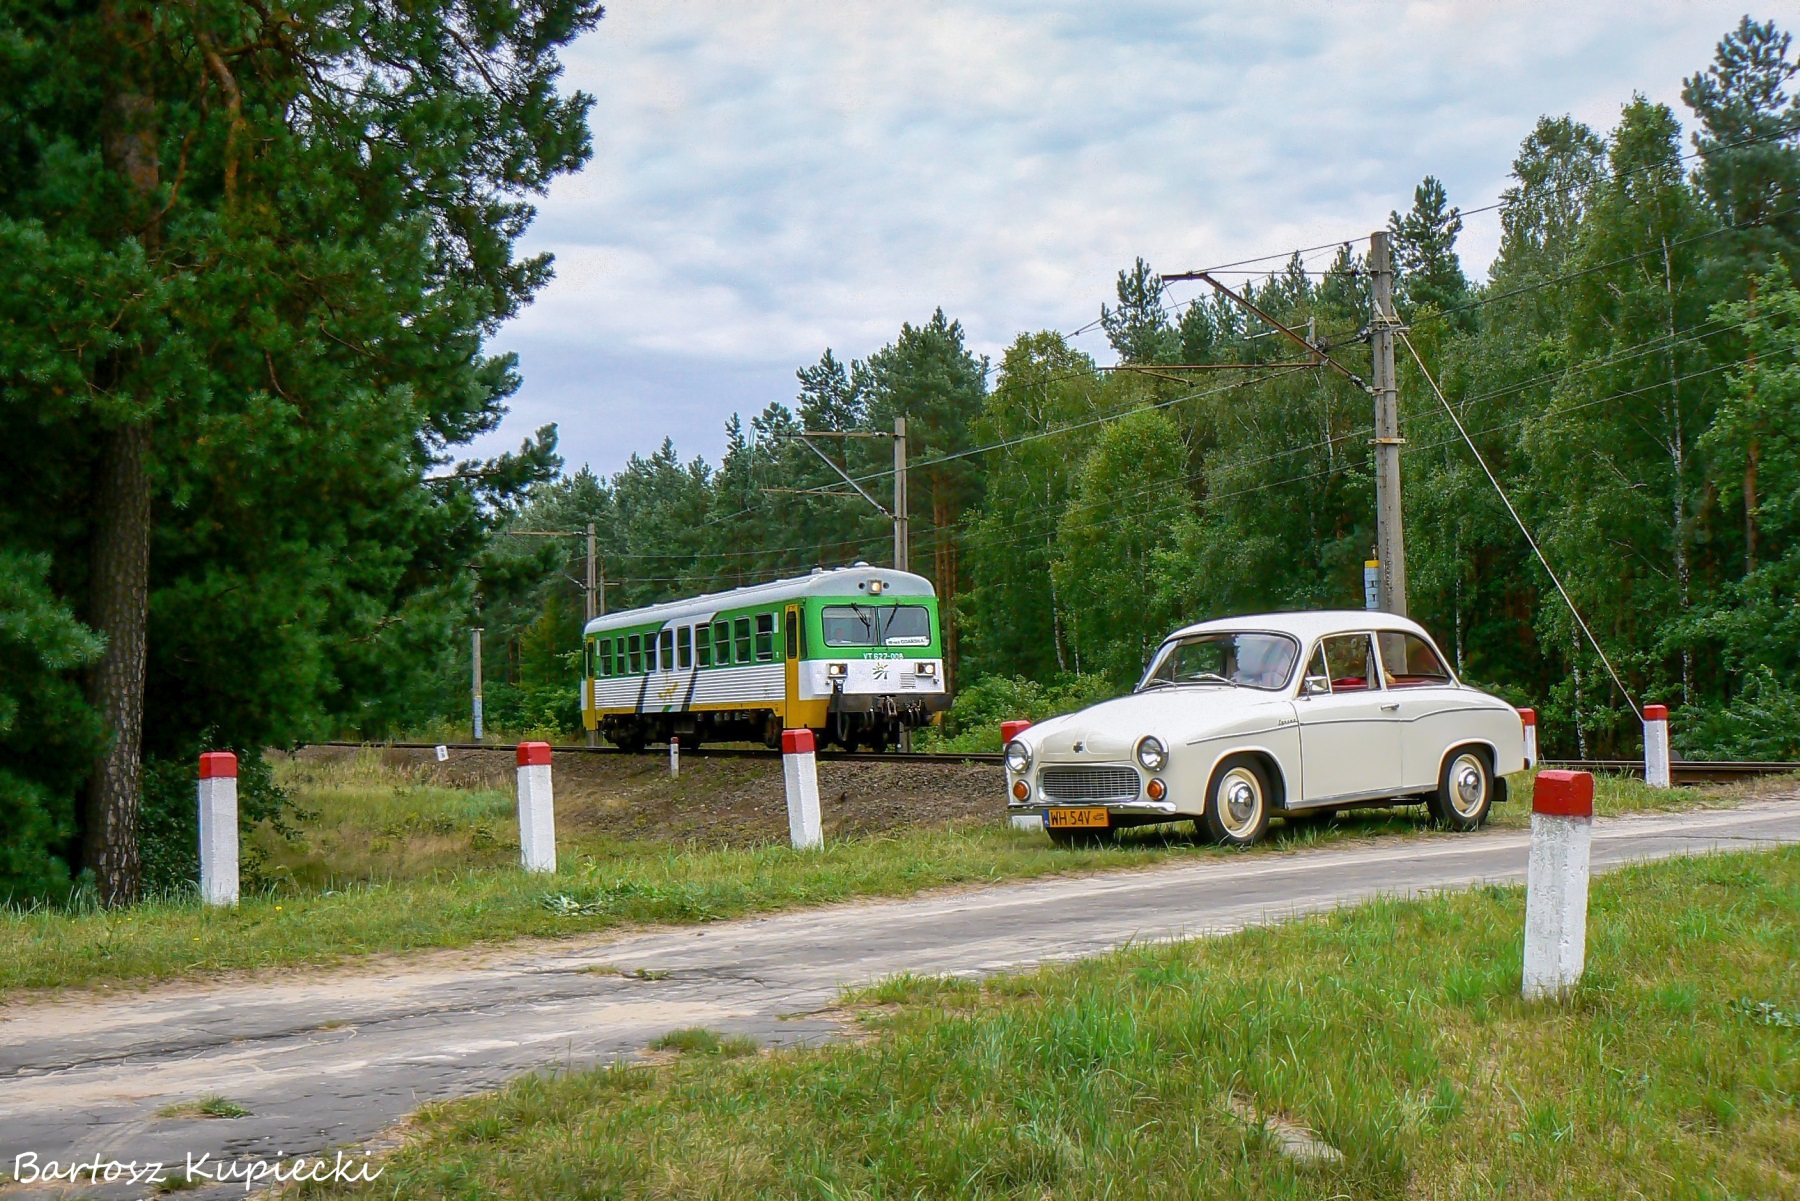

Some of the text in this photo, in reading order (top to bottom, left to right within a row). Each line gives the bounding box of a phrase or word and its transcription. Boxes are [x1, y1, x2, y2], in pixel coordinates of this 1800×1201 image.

[863, 652, 873, 660] VT
[1050, 810, 1091, 826] WH 54V
